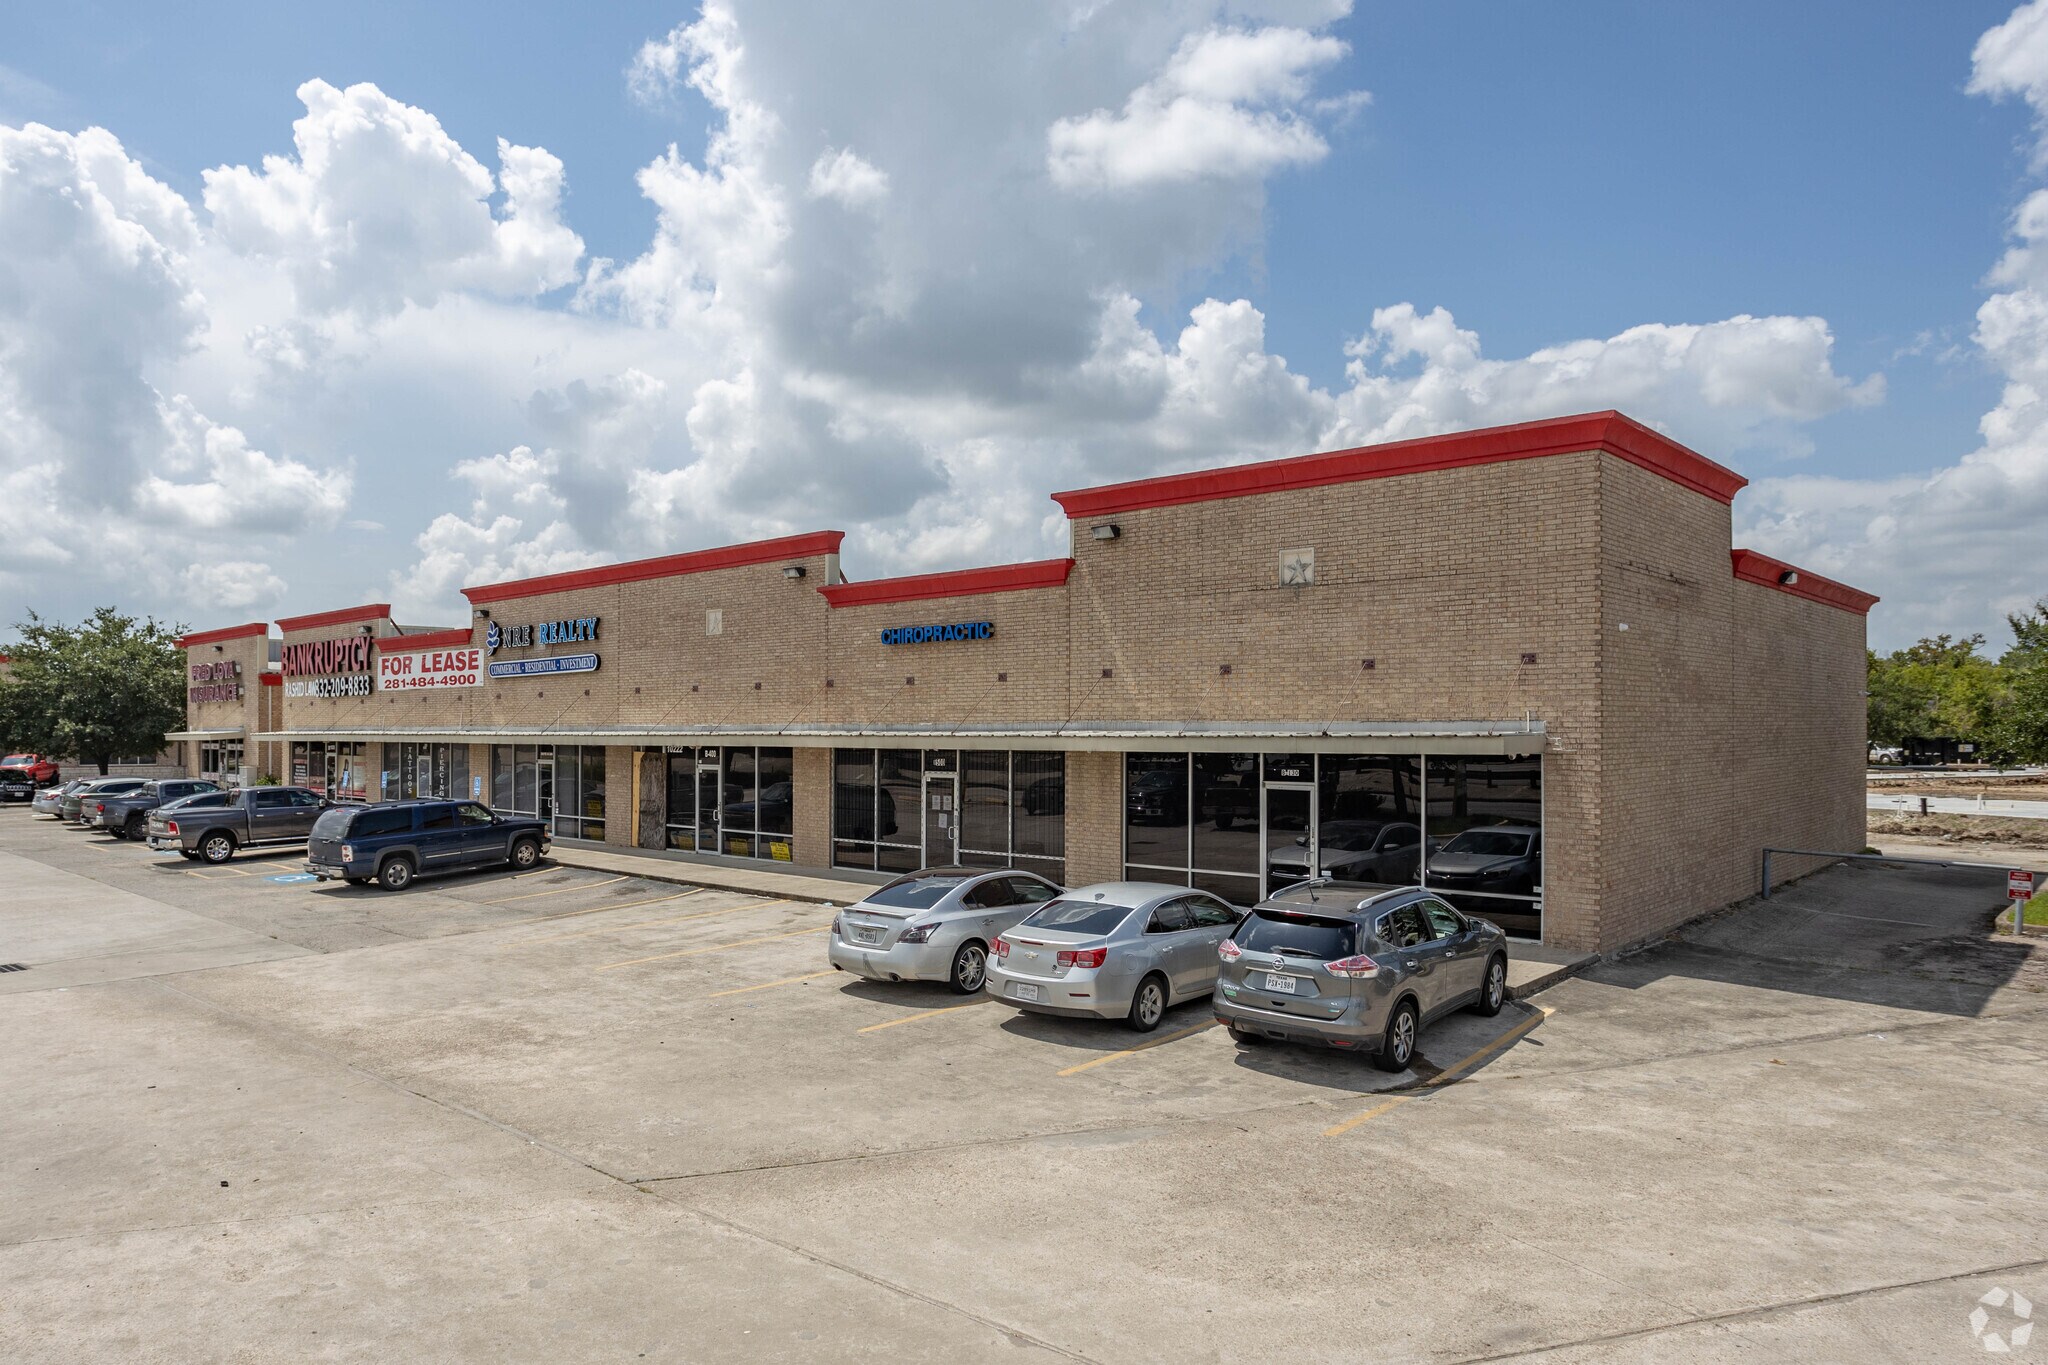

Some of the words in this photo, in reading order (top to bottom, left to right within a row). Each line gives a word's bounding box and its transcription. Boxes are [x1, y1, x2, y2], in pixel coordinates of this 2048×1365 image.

[502, 625, 533, 648] NRE
[538, 617, 597, 645] REALTY
[881, 621, 995, 645] CHIROPRACTIC
[281, 636, 373, 677] BANKRUPTCY
[381, 656, 413, 676] FOR
[421, 650, 479, 673] LEASE
[490, 664, 522, 675] COMMERCIAL
[525, 661, 557, 672] RESIDENTIAL
[560, 656, 594, 670] INVESTMENT
[192, 664, 211, 682] FRED
[213, 661, 235, 680] LOYA
[190, 683, 238, 702] INSURANCE
[315, 675, 372, 697] 832-209-8833
